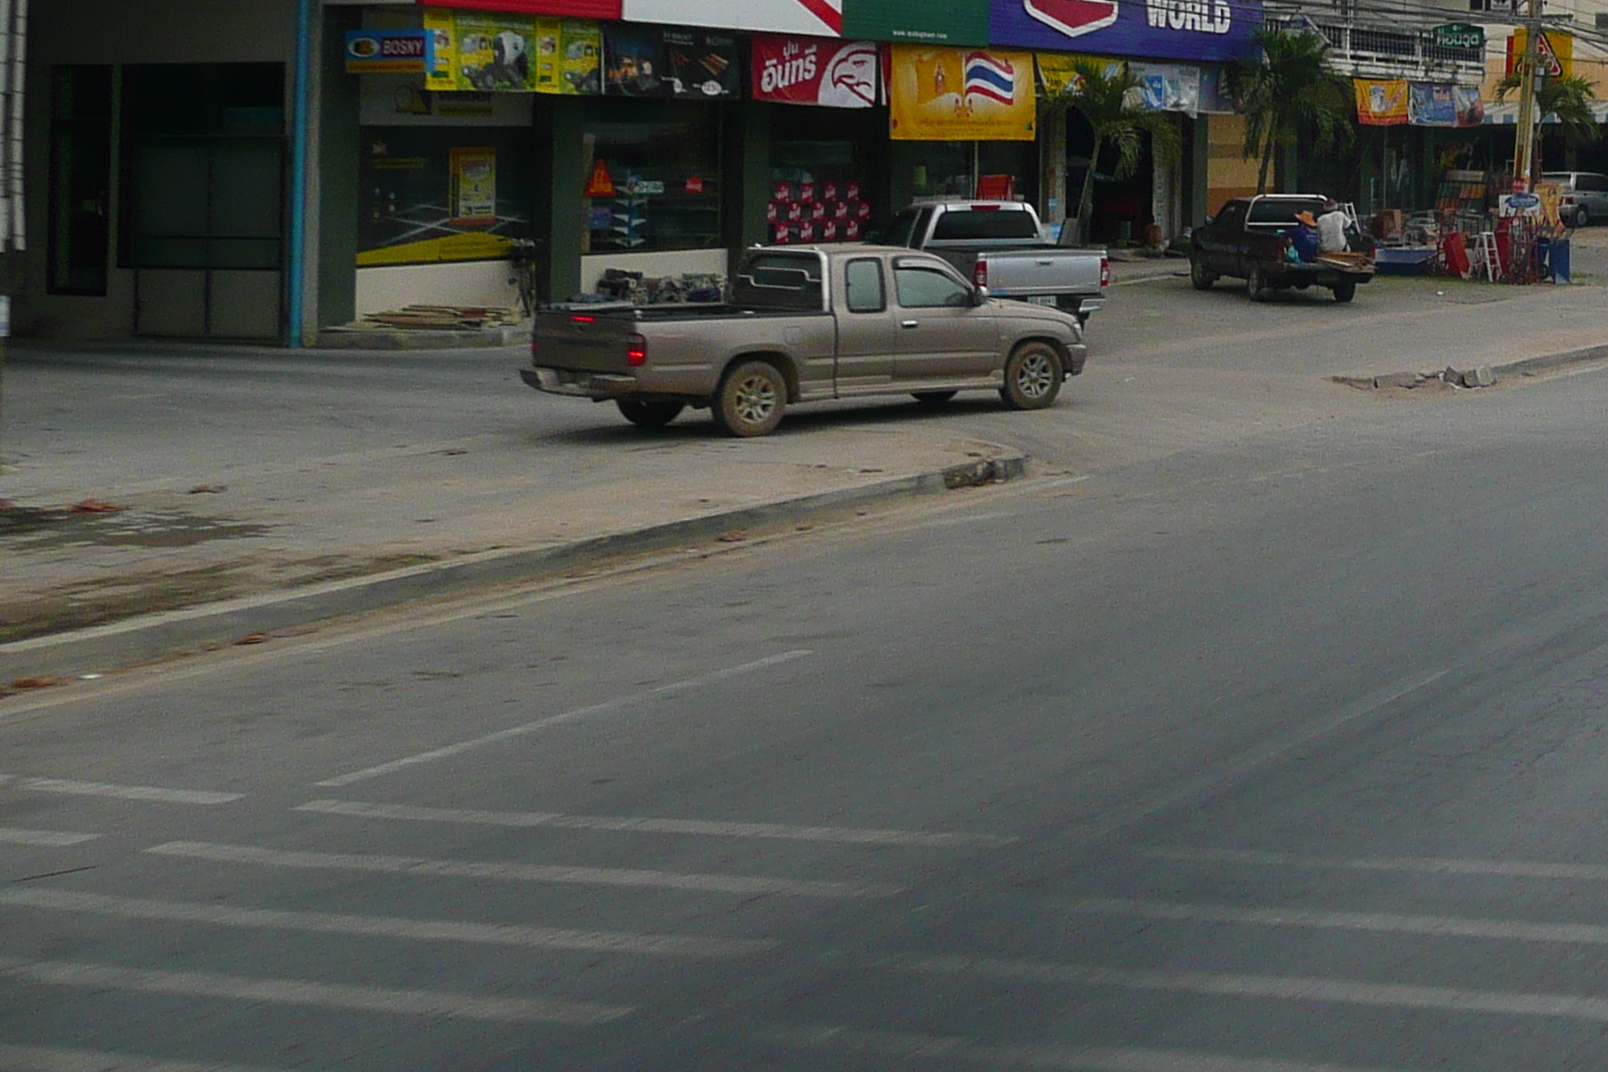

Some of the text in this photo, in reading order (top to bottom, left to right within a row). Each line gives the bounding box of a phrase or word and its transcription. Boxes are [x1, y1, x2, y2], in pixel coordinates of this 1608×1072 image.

[382, 39, 424, 55] BOSNY
[761, 44, 817, 93] อินทรี
